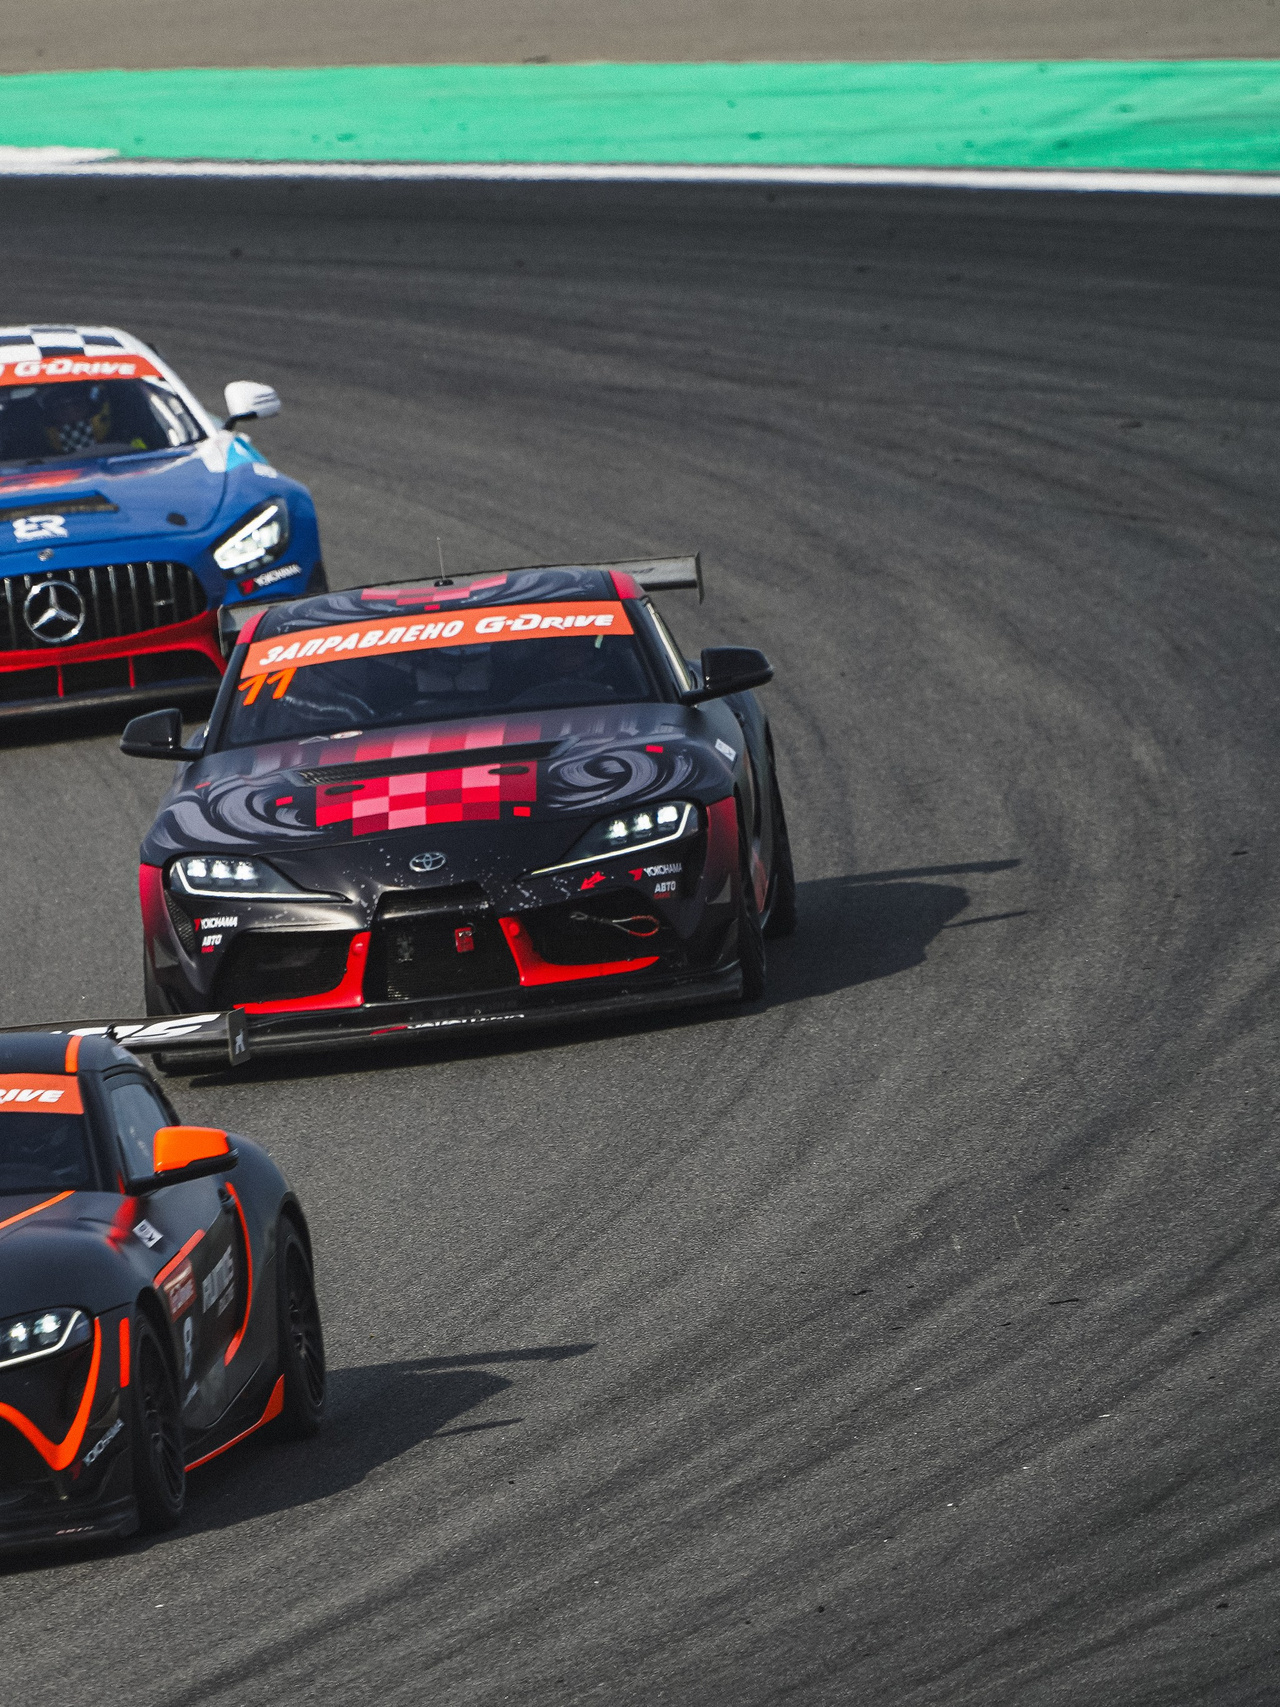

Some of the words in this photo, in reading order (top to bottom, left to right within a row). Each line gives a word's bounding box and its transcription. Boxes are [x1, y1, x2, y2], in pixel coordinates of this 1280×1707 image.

[258, 619, 465, 667] ЗАПРАВЛЕНО
[237, 667, 297, 706] 11
[643, 862, 683, 877] YOKOHAMA
[654, 881, 676, 893] АВТО
